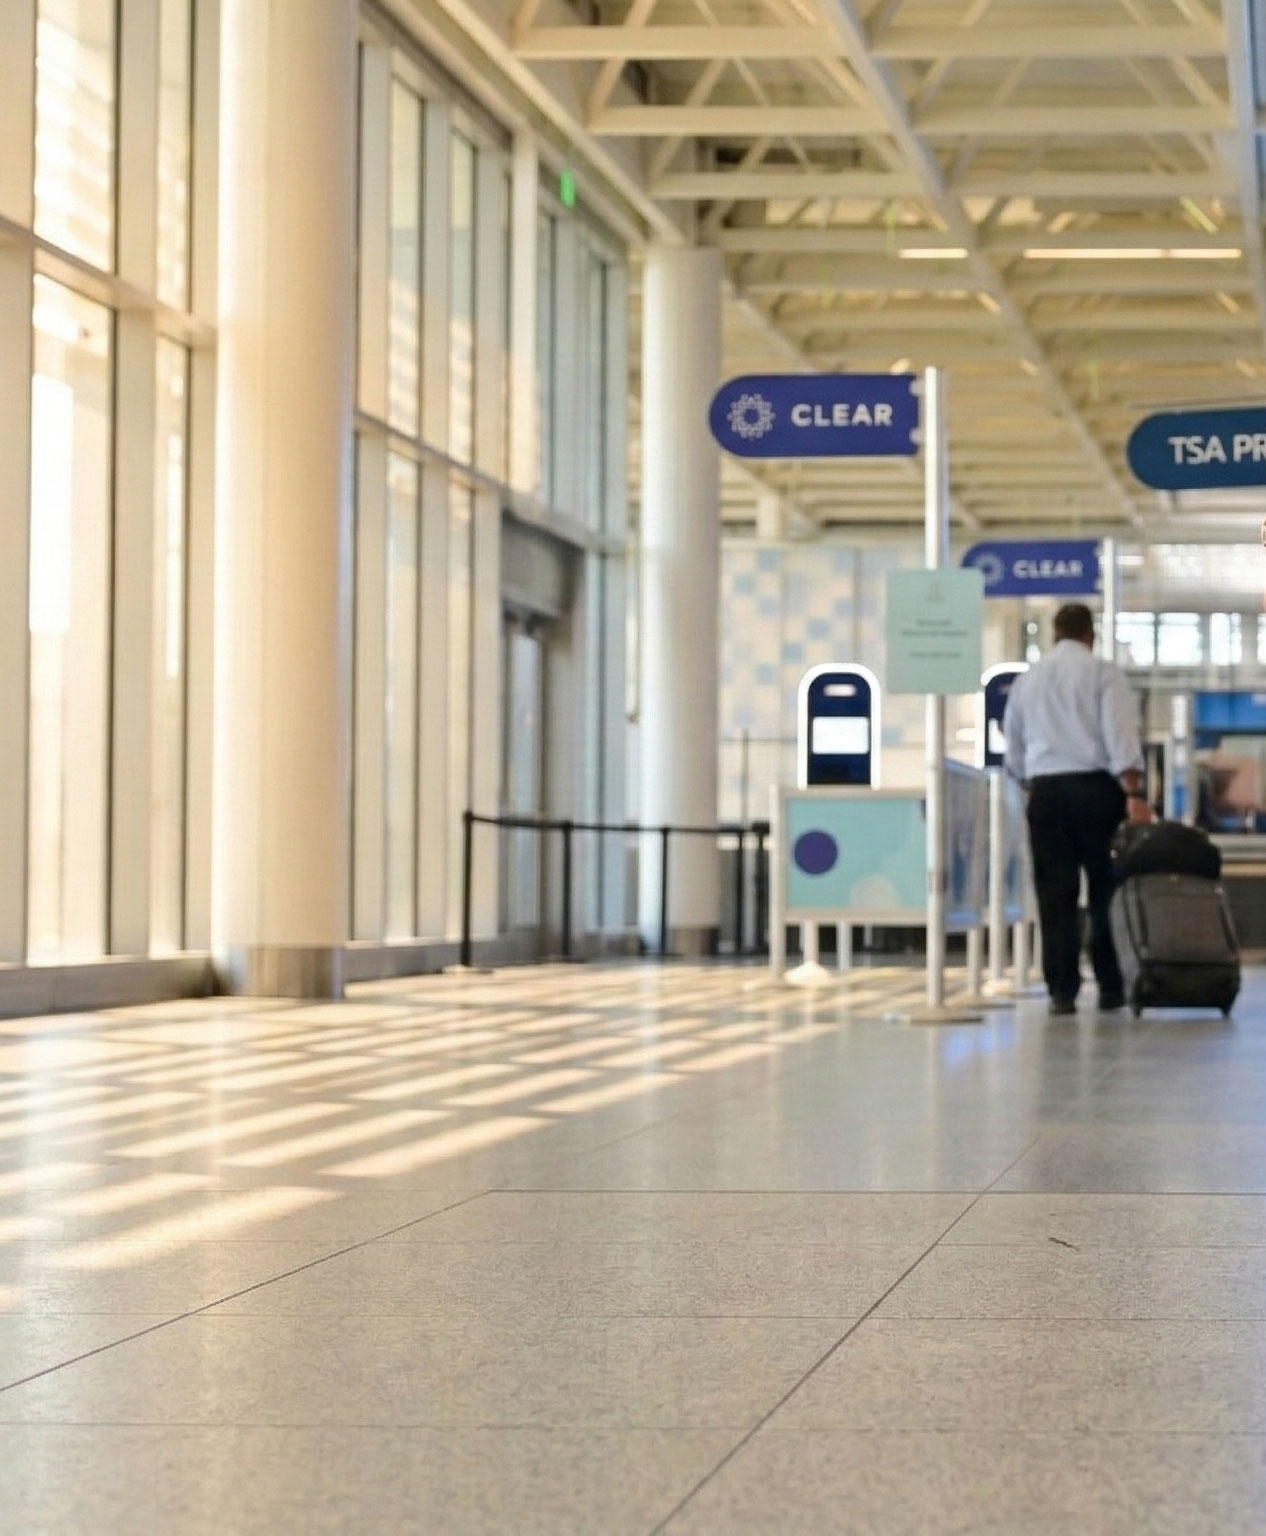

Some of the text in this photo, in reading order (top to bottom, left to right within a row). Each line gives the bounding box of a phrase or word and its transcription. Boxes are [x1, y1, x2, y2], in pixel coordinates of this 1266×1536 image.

[791, 403, 893, 427] CLEAR
[1167, 435, 1227, 465] TSA
[1013, 559, 1084, 579] CLEAR
